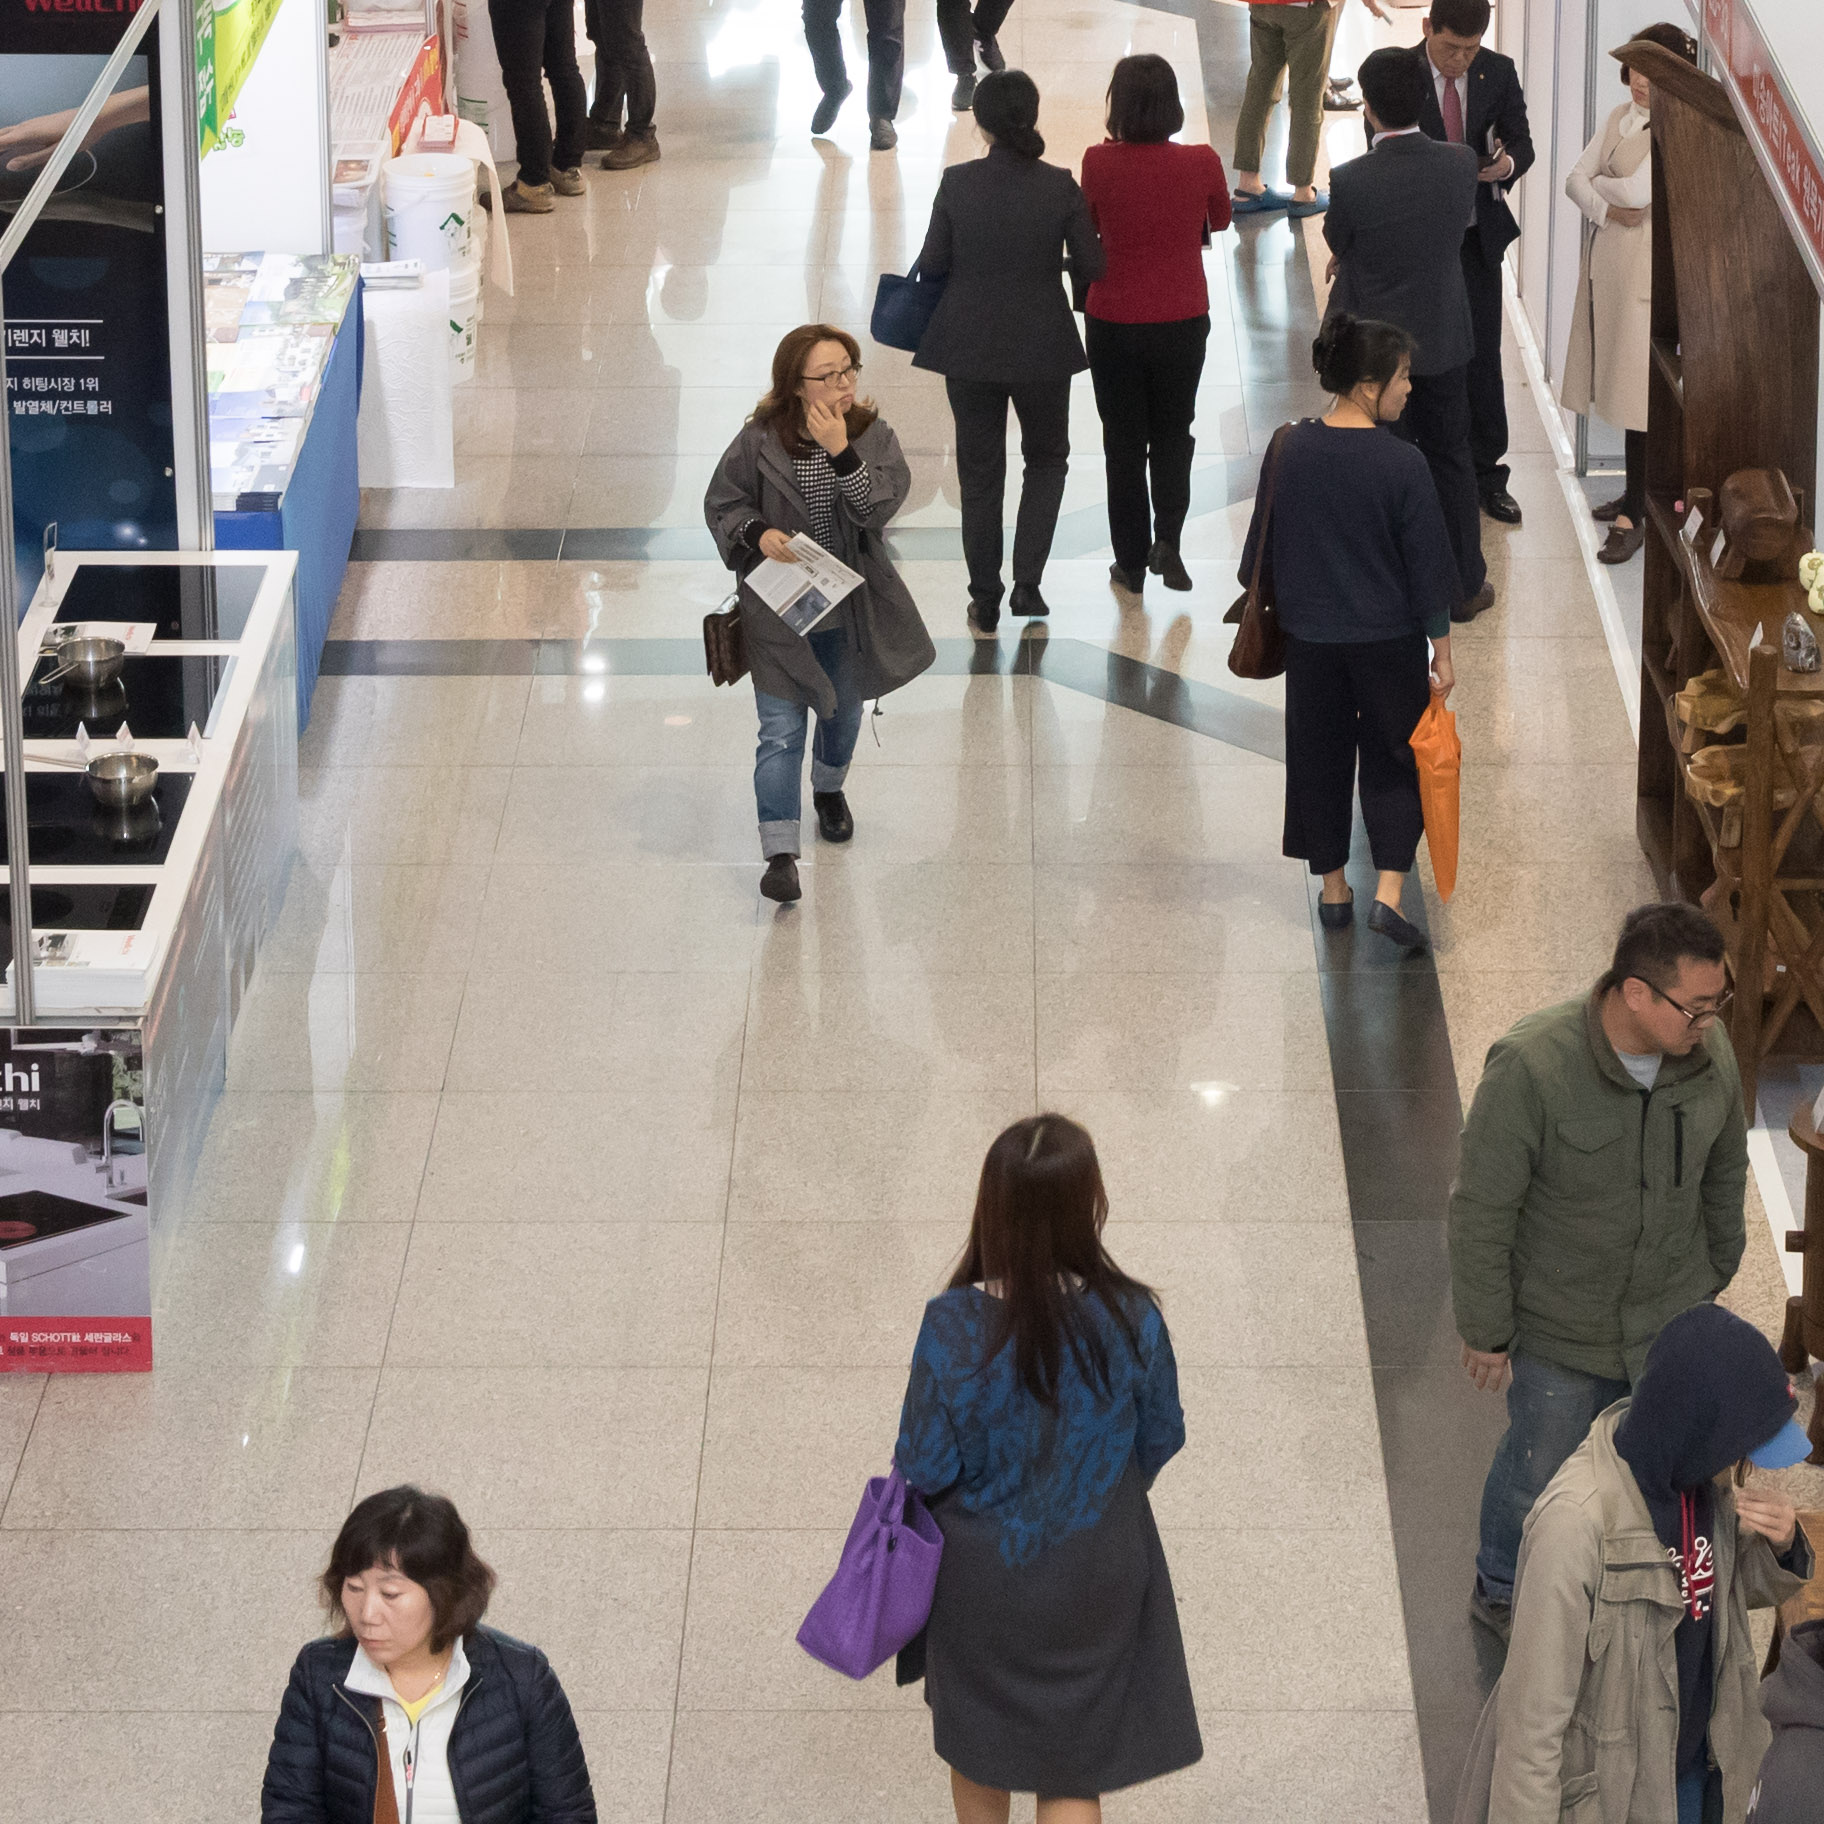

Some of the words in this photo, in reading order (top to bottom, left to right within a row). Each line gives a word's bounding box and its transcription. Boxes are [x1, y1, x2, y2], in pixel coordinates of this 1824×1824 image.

[52, 328, 91, 348] 웰치!
[23, 377, 75, 392] 히팅시장
[81, 377, 99, 391] 1위
[13, 400, 112, 415] 발열체/컨트롤러
[18, 1098, 41, 1111] 웰치
[9, 1331, 29, 1344] 독일
